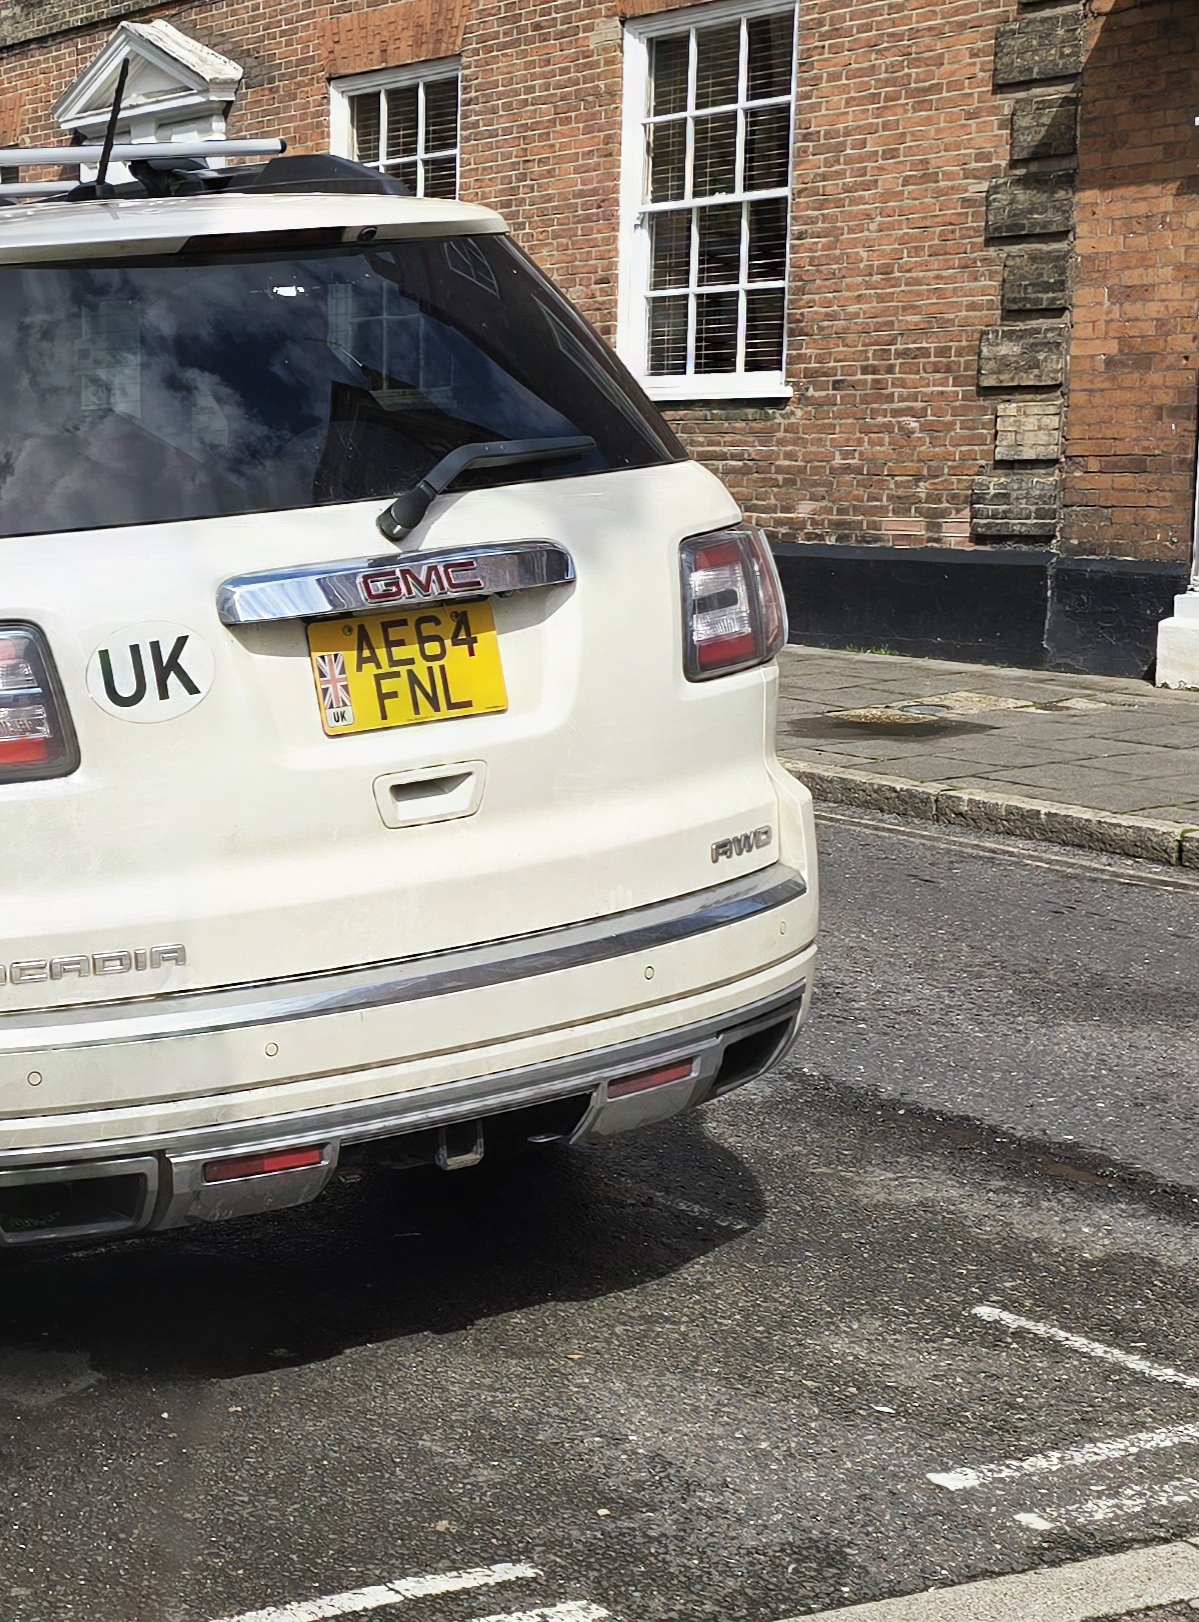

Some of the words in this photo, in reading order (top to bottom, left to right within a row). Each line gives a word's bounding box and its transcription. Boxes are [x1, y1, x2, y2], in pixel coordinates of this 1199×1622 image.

[358, 560, 484, 603] GMC
[355, 610, 478, 672] AE64
[98, 635, 201, 707] UK
[373, 663, 473, 721] FNL
[332, 710, 348, 723] UK
[710, 825, 773, 864] AWD
